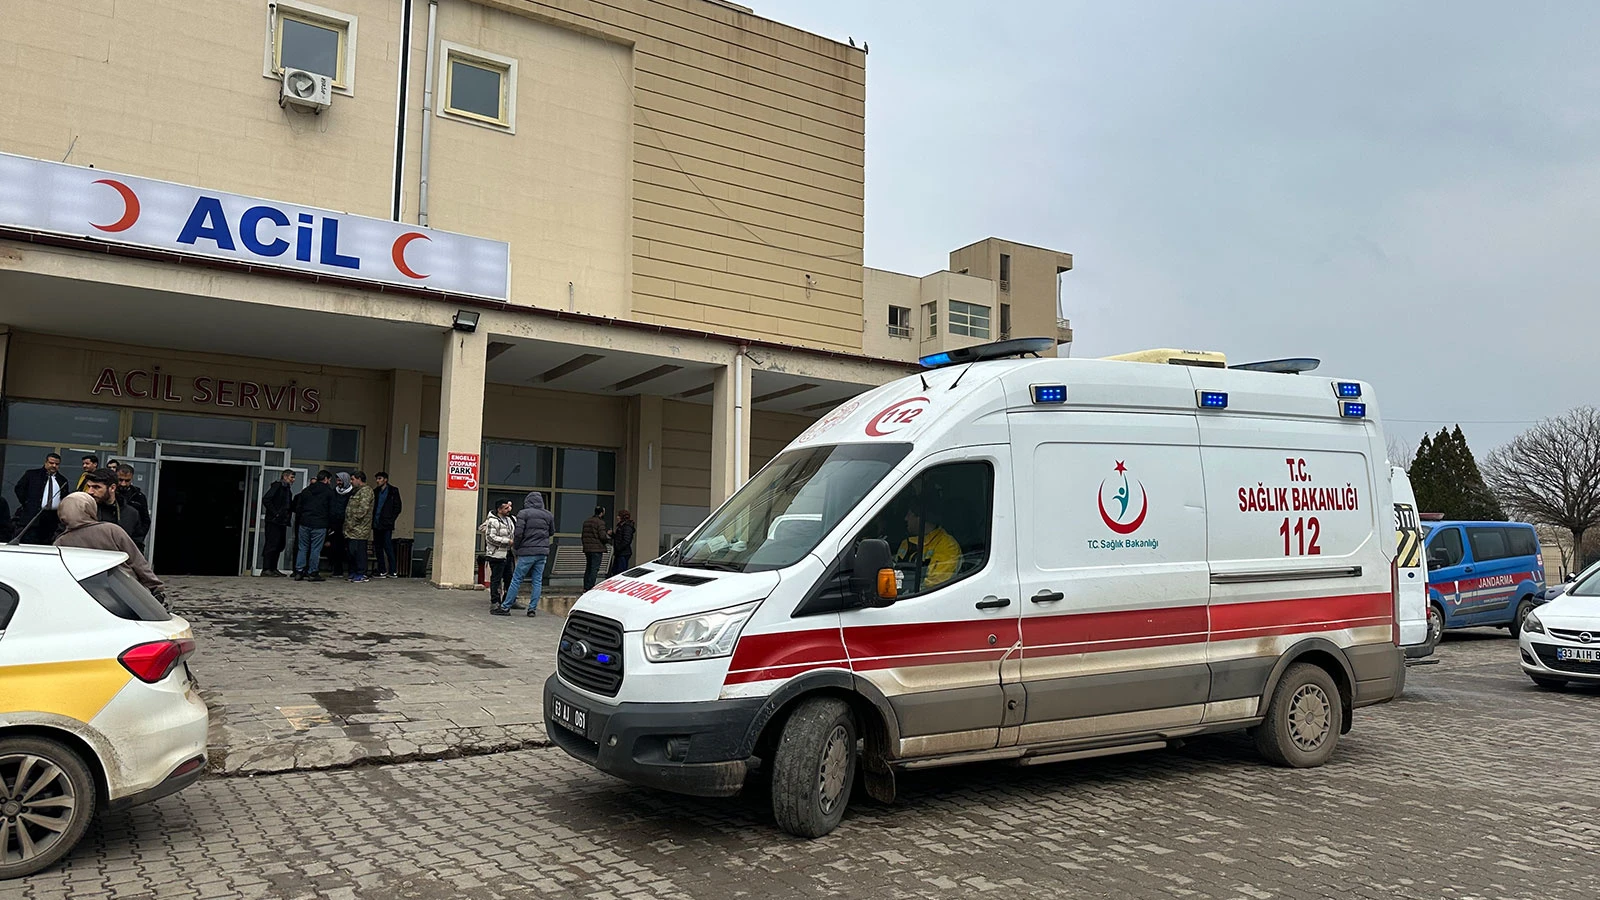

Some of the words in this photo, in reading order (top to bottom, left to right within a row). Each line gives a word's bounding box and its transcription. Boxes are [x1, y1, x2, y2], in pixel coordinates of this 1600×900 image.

[91, 365, 182, 402] ACİL
[192, 376, 321, 414] SERVİS
[881, 408, 924, 424] 112
[1285, 458, 1312, 482] T.C.
[1238, 481, 1289, 512] SAĞLIK
[1291, 482, 1359, 511] BAKANLIĞI
[1100, 539, 1124, 551] Sağlık
[1125, 538, 1159, 550] Bakanlığı
[1279, 516, 1321, 556] 112
[1478, 574, 1514, 589] JANDARMA
[1562, 648, 1572, 658] 33
